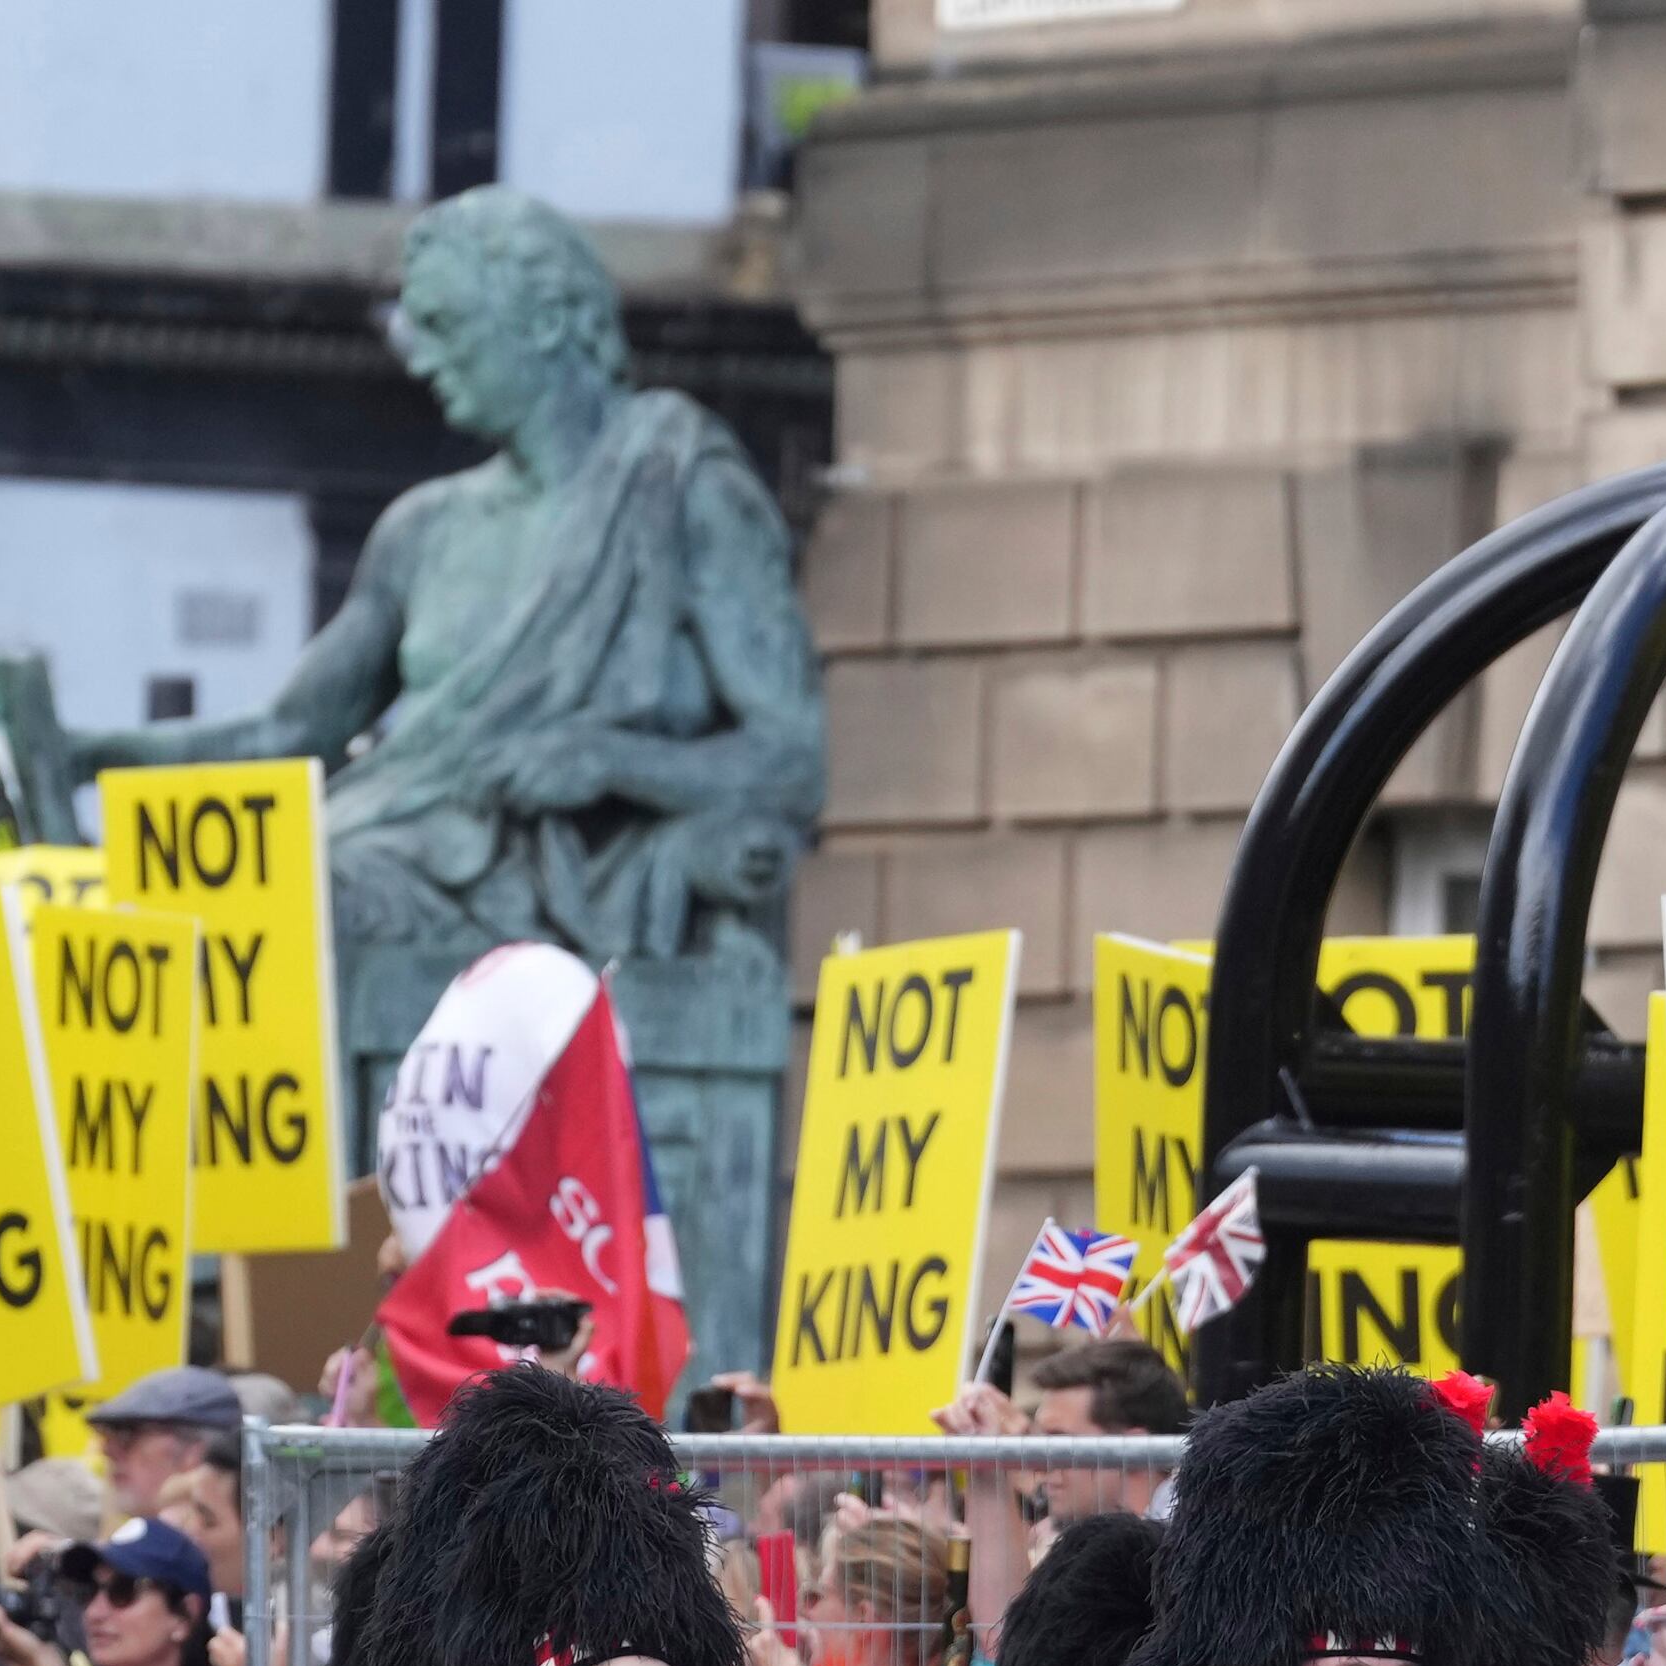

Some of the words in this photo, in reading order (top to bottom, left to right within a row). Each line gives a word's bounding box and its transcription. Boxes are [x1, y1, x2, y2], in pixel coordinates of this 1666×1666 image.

[136, 795, 275, 895] NOT
[59, 934, 170, 1036] NOT
[840, 969, 973, 1079] NOT
[1118, 973, 1208, 1088] NO
[1316, 970, 1475, 1042] OT
[71, 1075, 154, 1176] MY
[836, 1112, 939, 1218] MY
[78, 1216, 171, 1321] ING
[791, 1256, 950, 1369] KING
